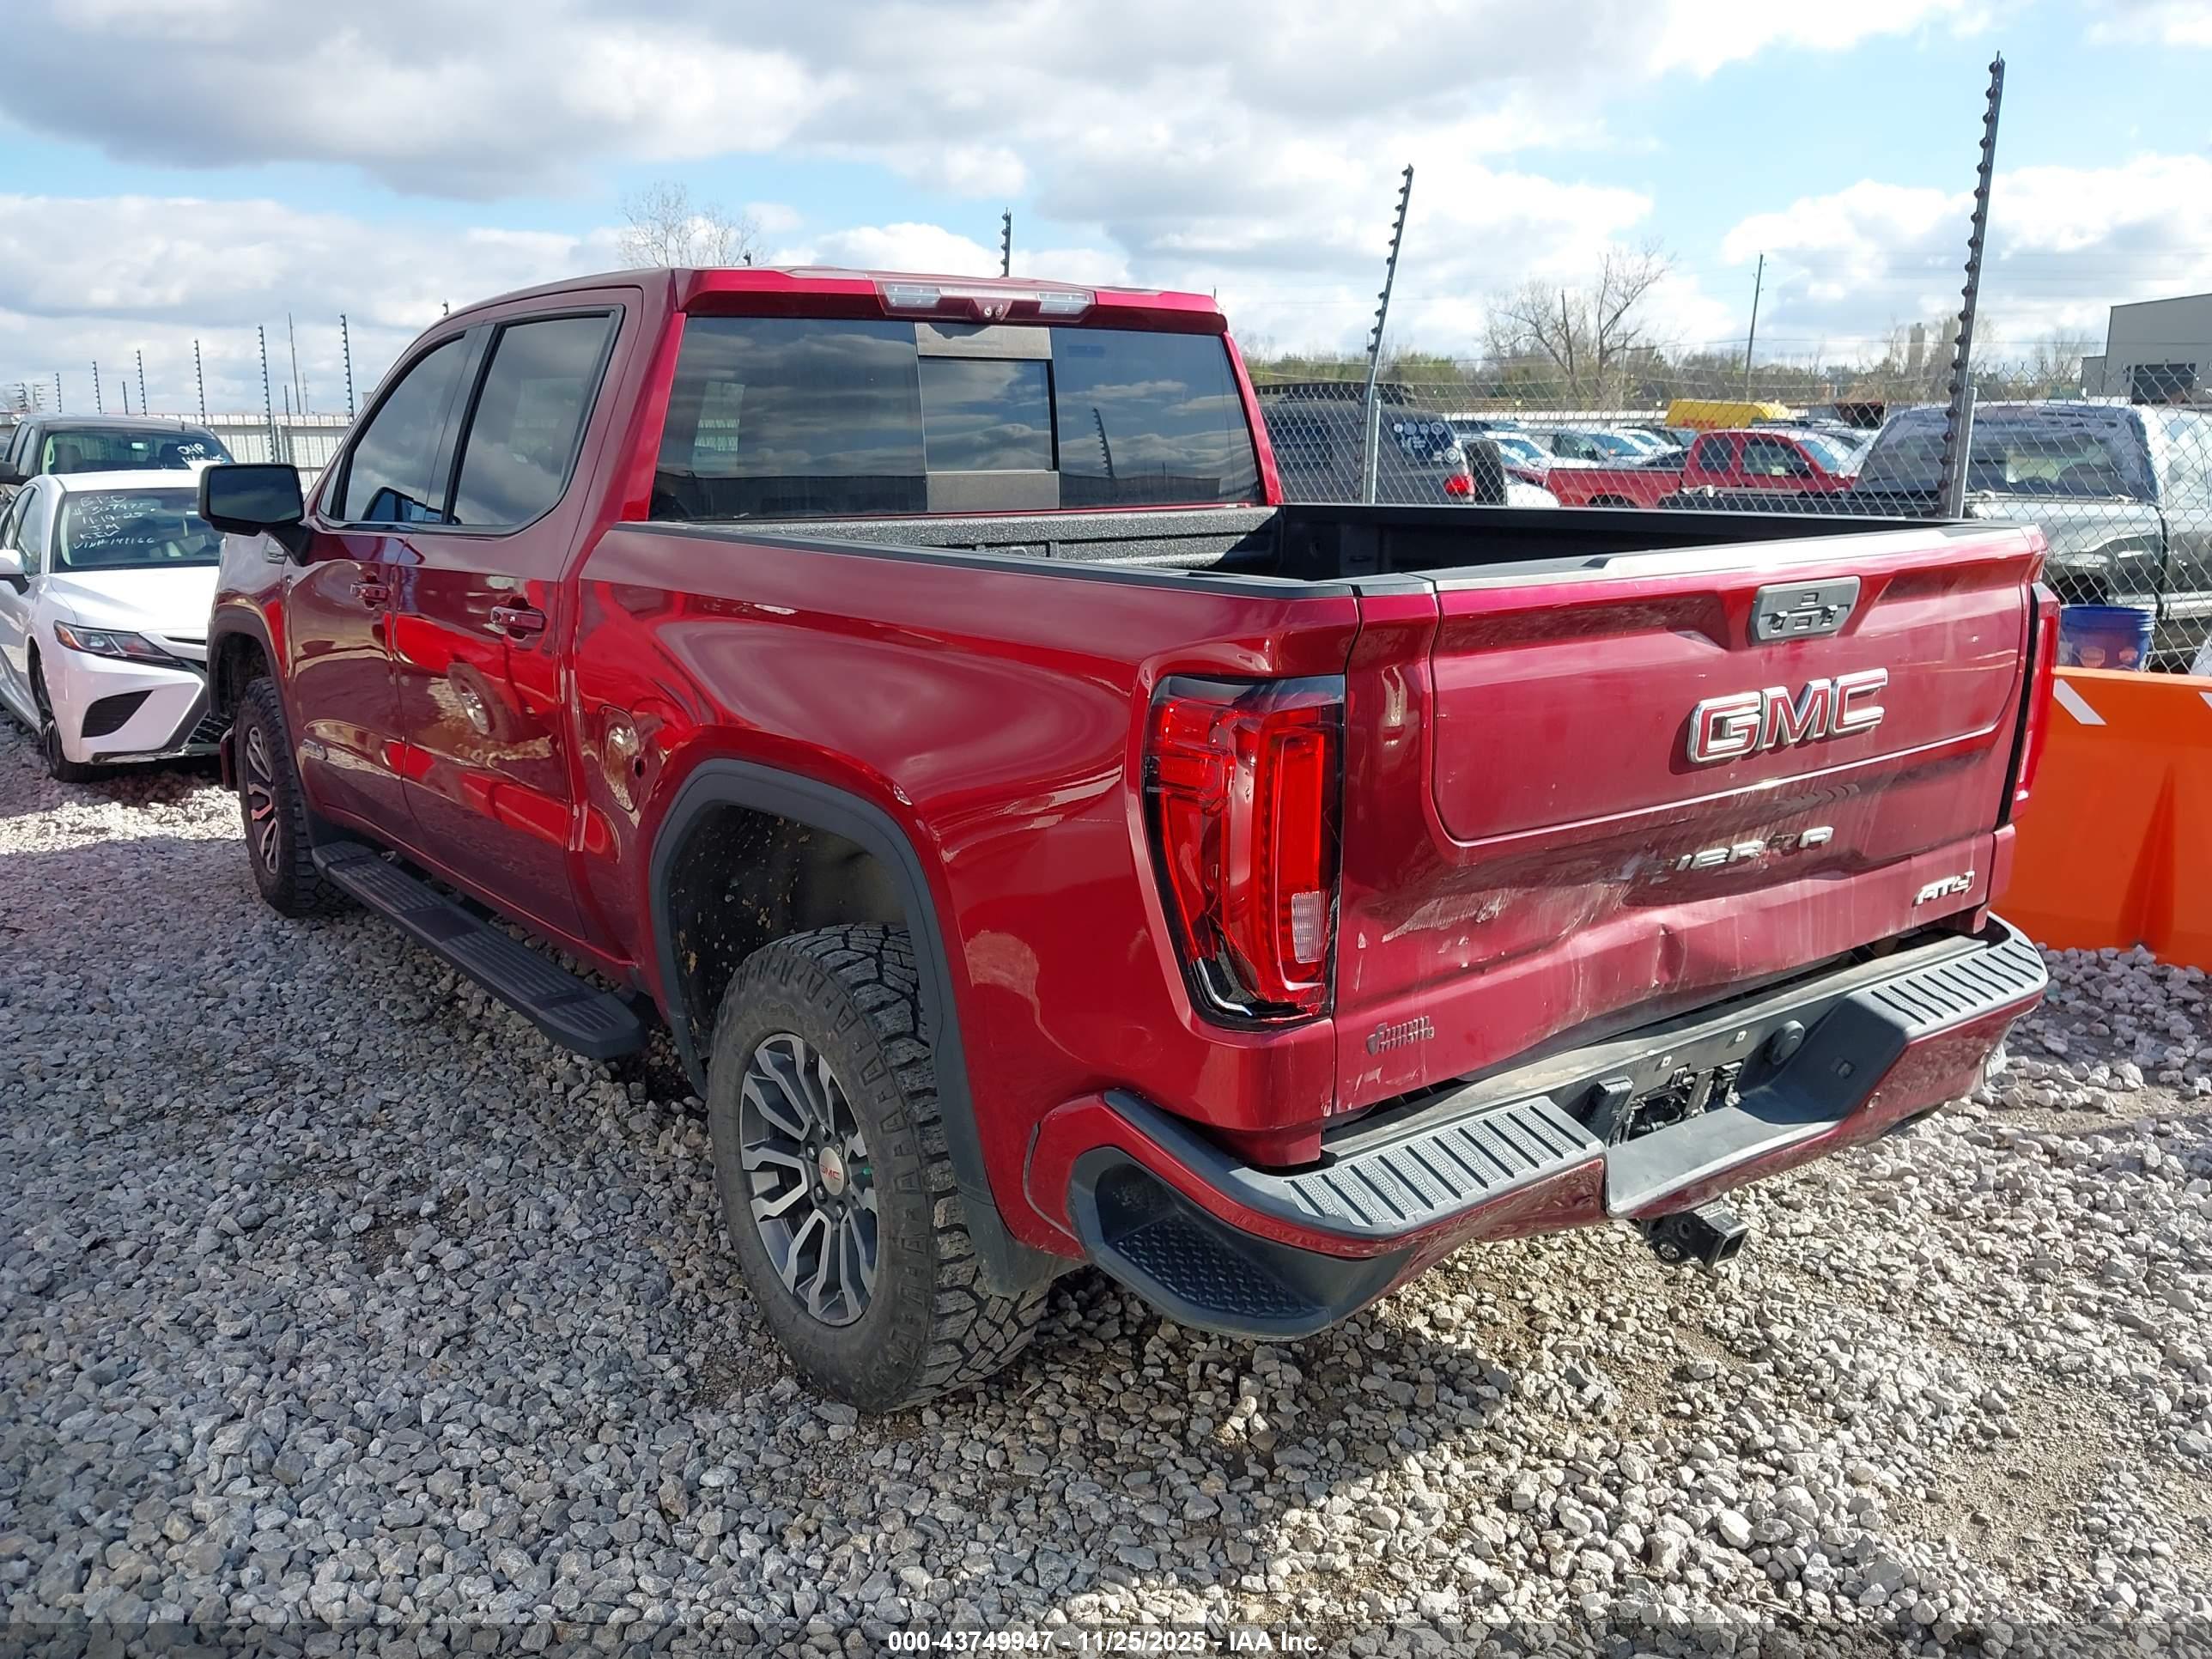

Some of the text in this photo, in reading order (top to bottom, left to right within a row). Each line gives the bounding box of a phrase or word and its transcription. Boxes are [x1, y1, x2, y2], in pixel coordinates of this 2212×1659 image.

[1687, 668, 1888, 763] GMC
[1913, 871, 1975, 907] AT4
[820, 1164, 841, 1182] GMC
